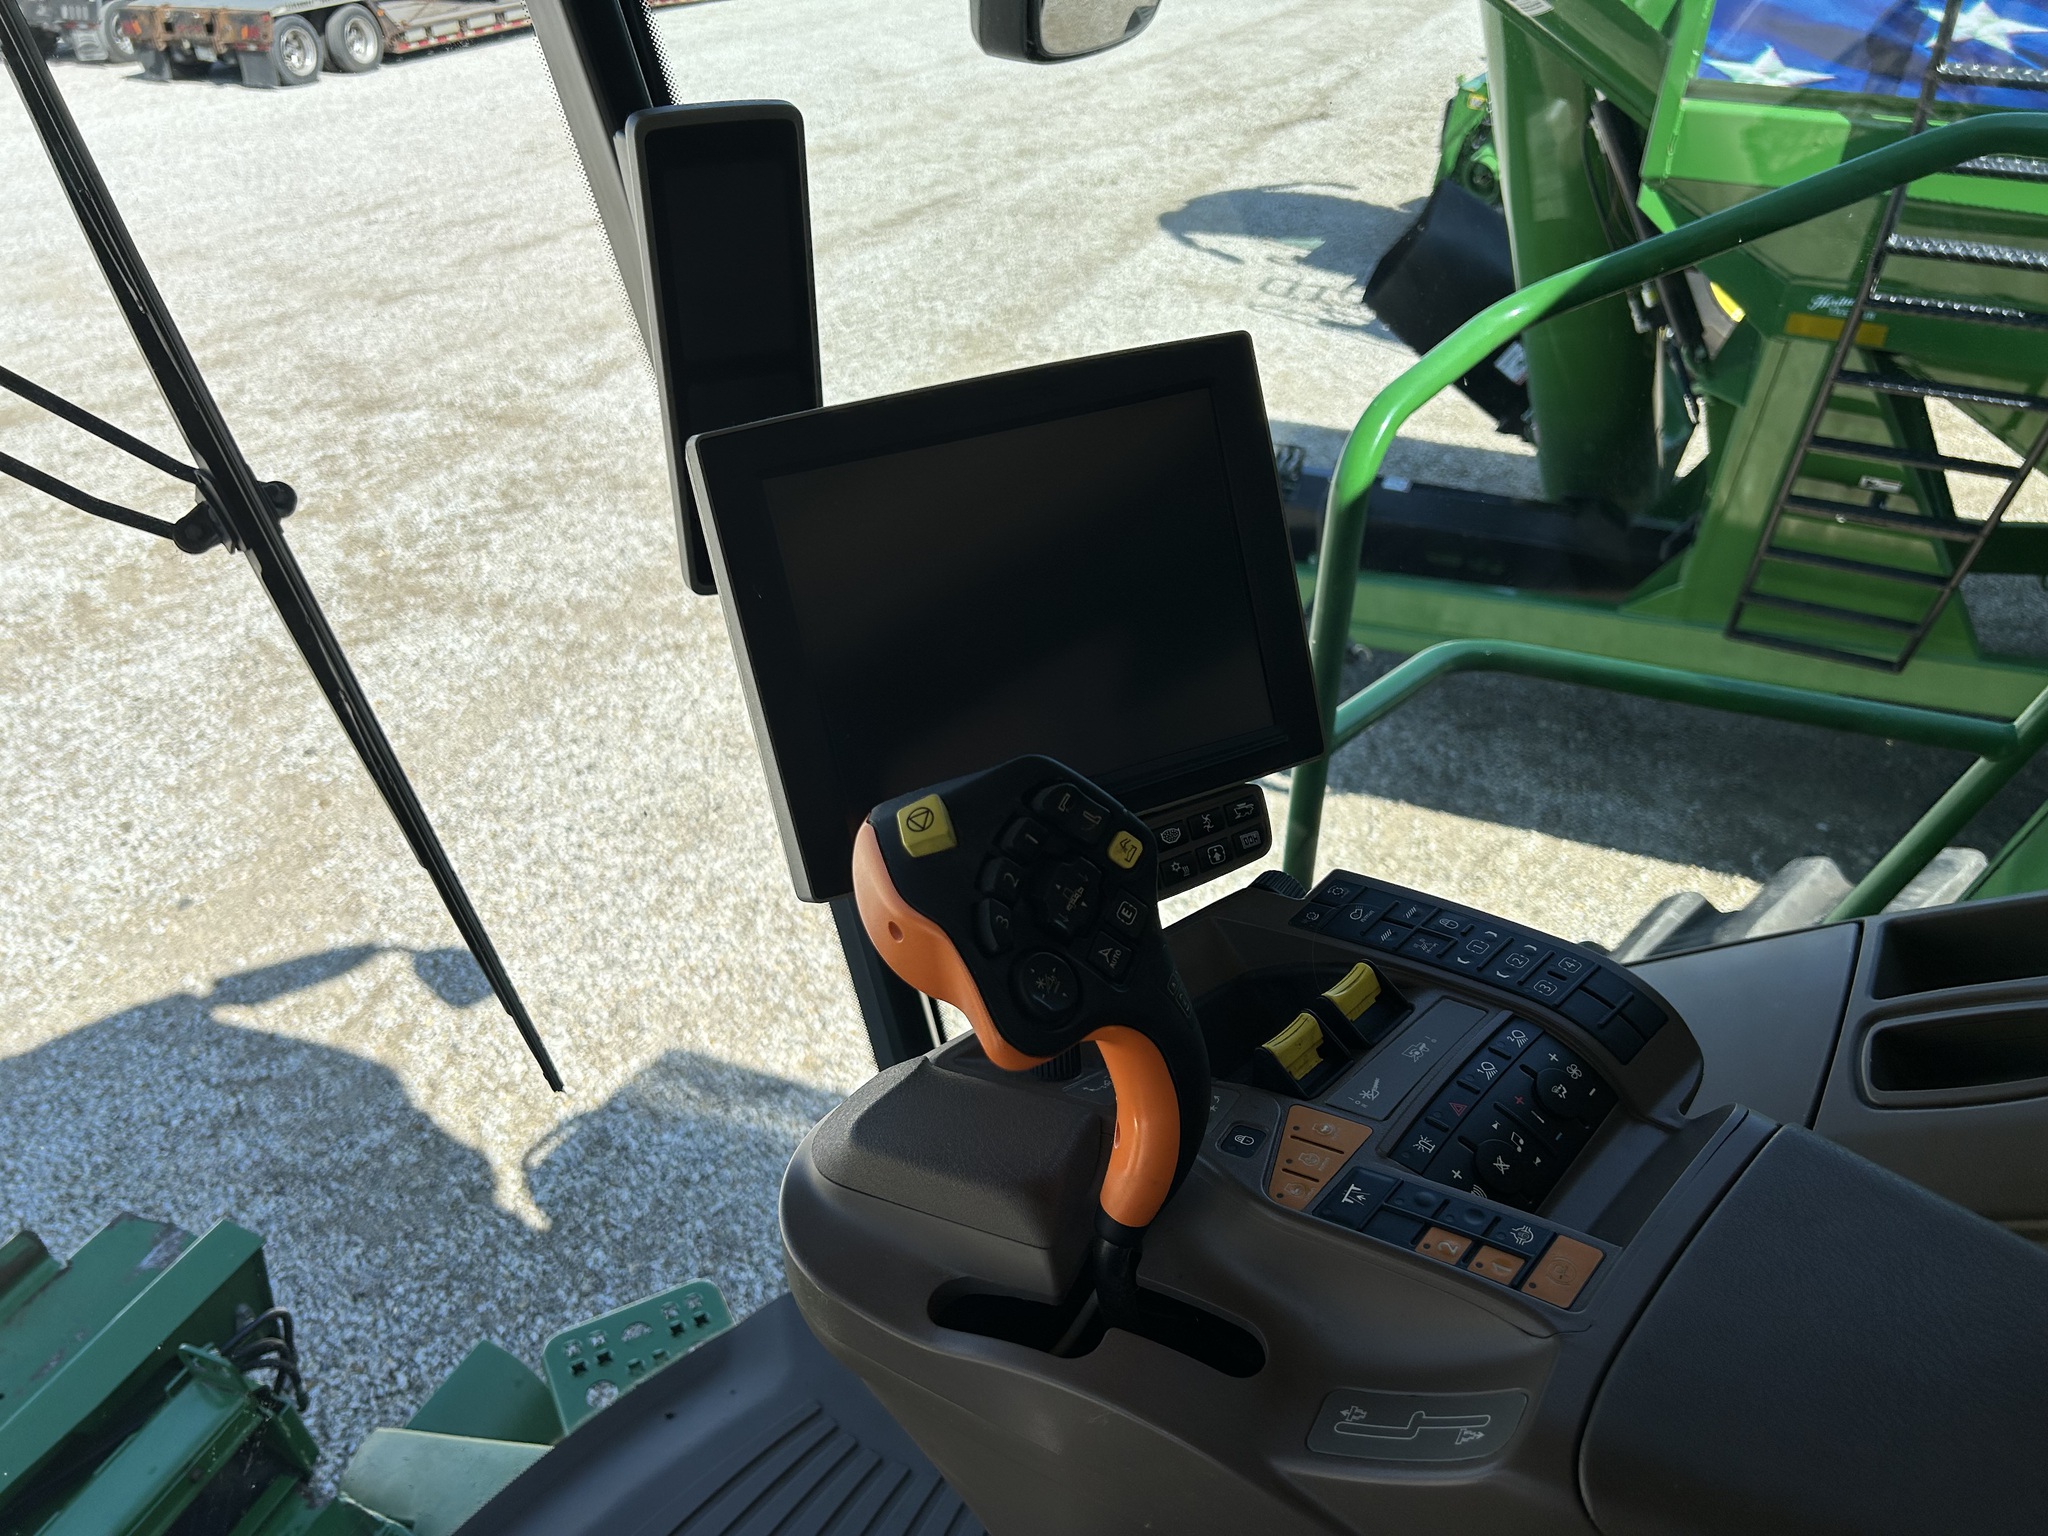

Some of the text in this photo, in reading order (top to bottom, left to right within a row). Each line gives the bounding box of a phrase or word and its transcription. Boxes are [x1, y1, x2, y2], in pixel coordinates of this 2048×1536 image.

[1025, 833, 1040, 845] 1
[1003, 873, 1019, 888] 2
[1121, 907, 1133, 920] E
[996, 915, 1010, 930] 3
[1109, 949, 1122, 969] AUTO
[1437, 1240, 1459, 1254] 2
